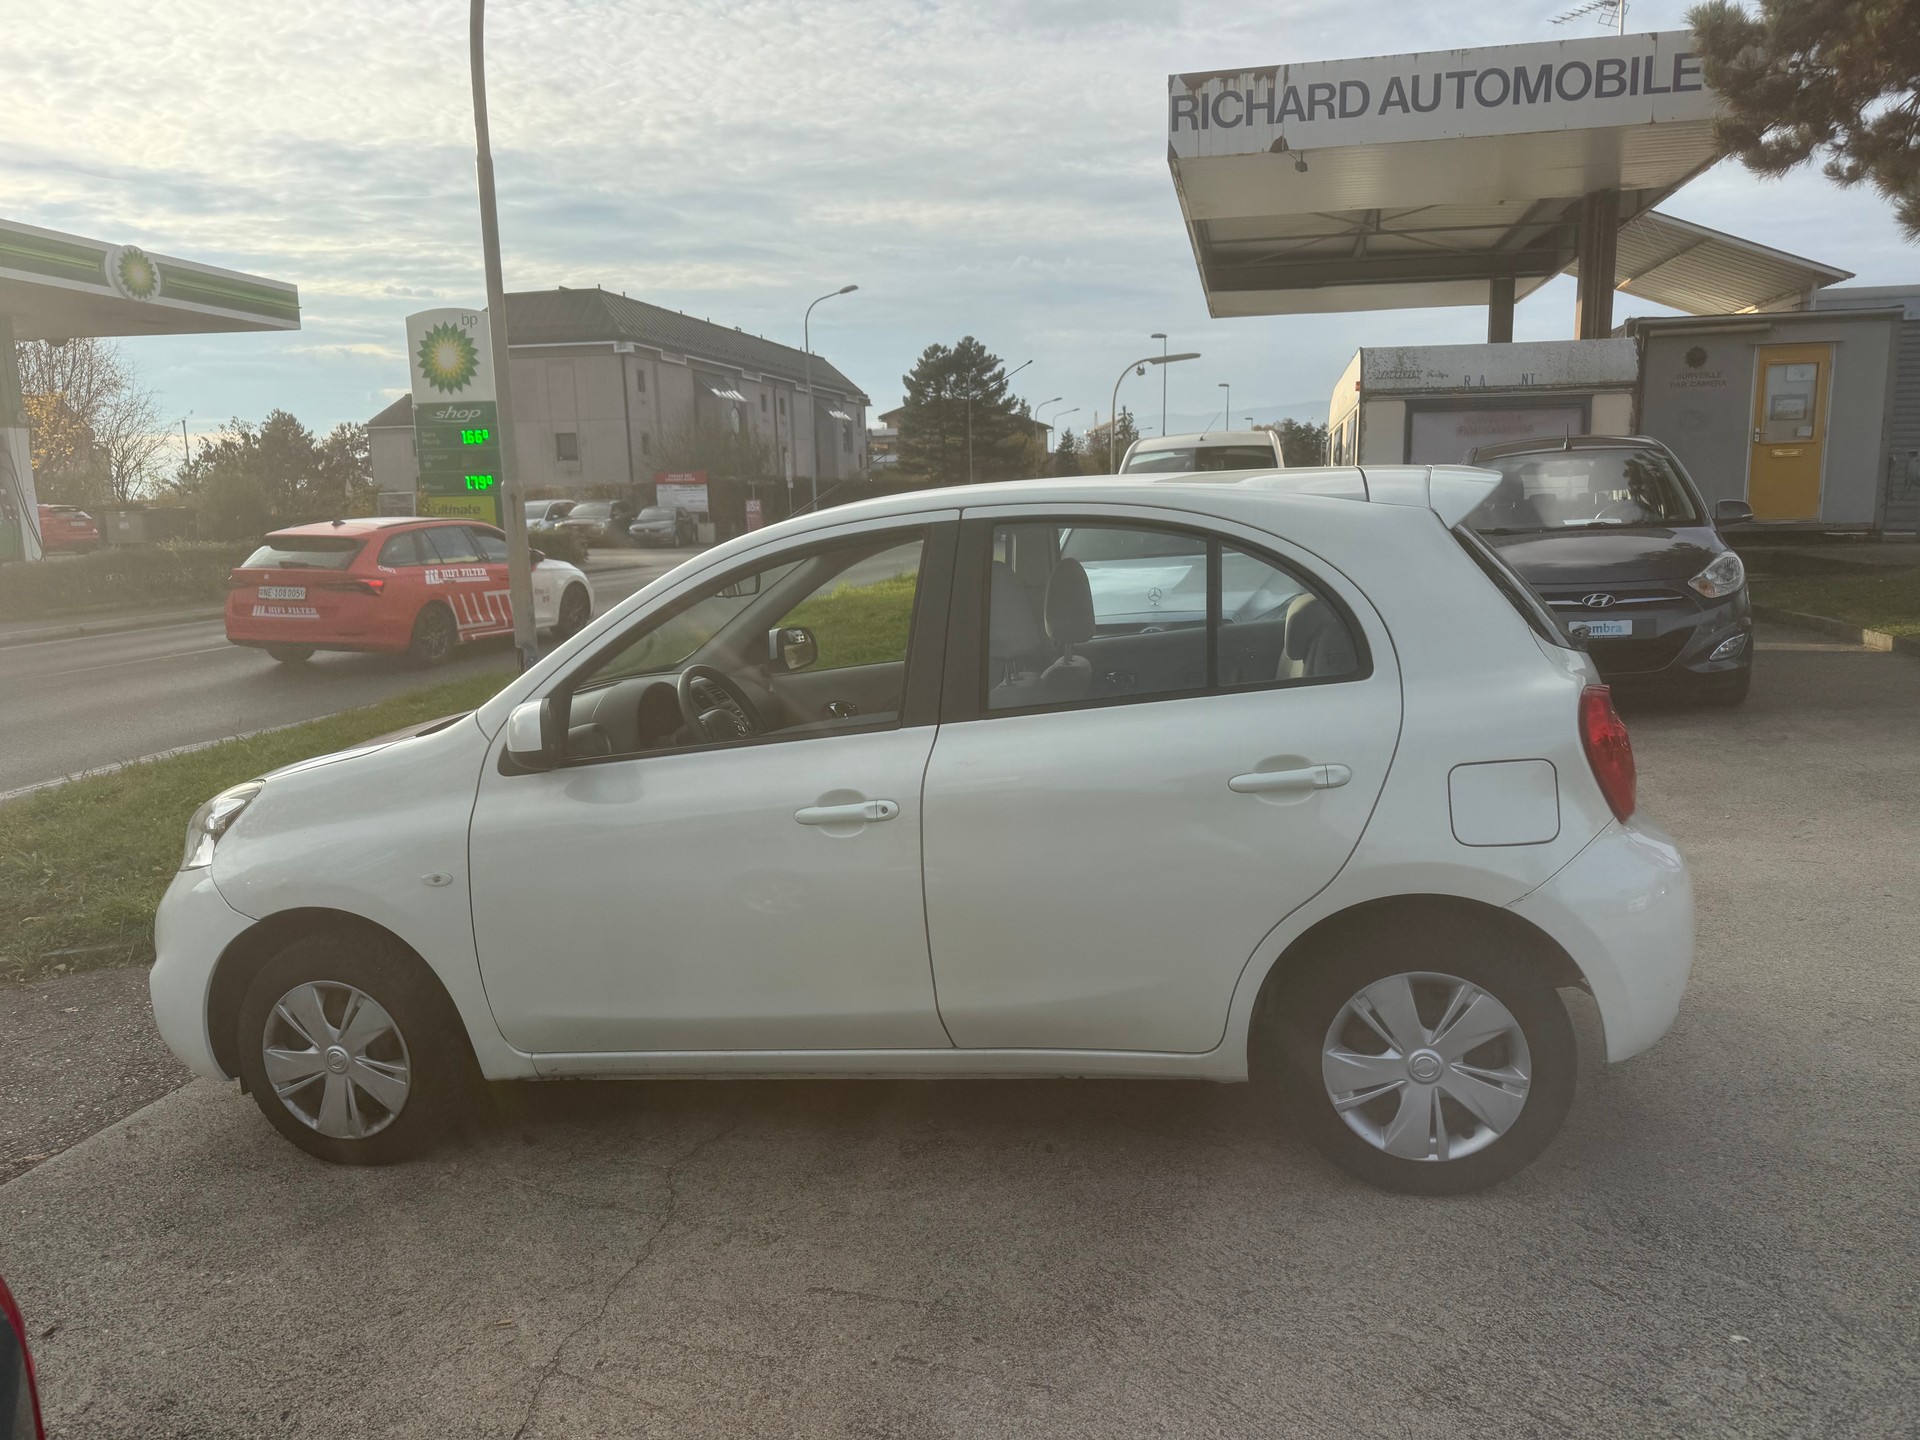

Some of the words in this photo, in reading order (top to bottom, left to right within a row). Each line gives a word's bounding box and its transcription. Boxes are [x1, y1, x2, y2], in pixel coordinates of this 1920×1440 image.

[1170, 79, 1370, 132] RICHARD
[460, 312, 478, 329] bp
[435, 405, 481, 423] shop
[440, 568, 459, 578] HIFI
[460, 567, 487, 577] FILTER
